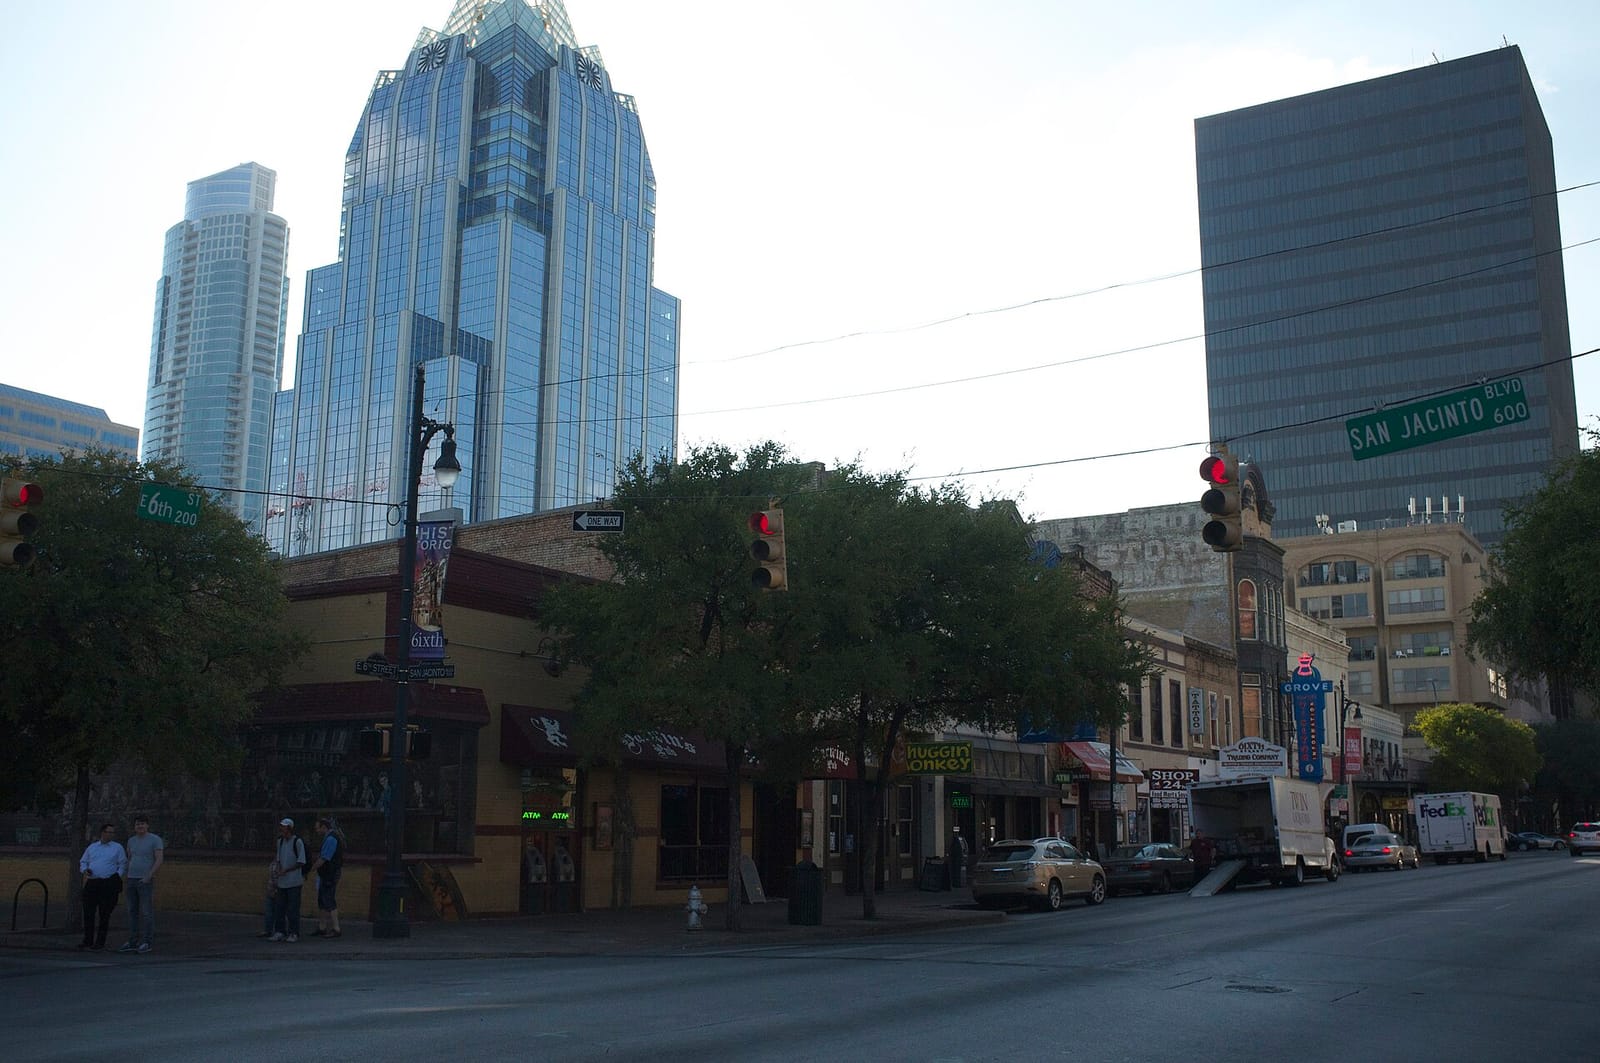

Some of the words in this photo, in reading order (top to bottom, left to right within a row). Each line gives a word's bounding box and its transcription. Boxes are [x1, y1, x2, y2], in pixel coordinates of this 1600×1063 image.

[1484, 378, 1522, 399] BLVD
[1493, 402, 1527, 424] 600
[1350, 420, 1391, 450] SAN
[1401, 397, 1484, 438] JACINTO
[140, 494, 148, 508] E
[148, 492, 173, 518] 6th
[187, 493, 201, 507] ST
[174, 510, 197, 526] 200
[587, 517, 602, 525] ONE
[603, 517, 619, 525] WAY
[411, 631, 443, 648] 6ixth
[1284, 682, 1329, 692] GROVE
[1191, 692, 1200, 728] TATTOO
[1252, 753, 1279, 761] COMPANY
[1152, 770, 1194, 781] SHOP
[522, 811, 542, 820] ATM
[551, 812, 569, 820] ATM
[1420, 802, 1466, 818] FedEx
